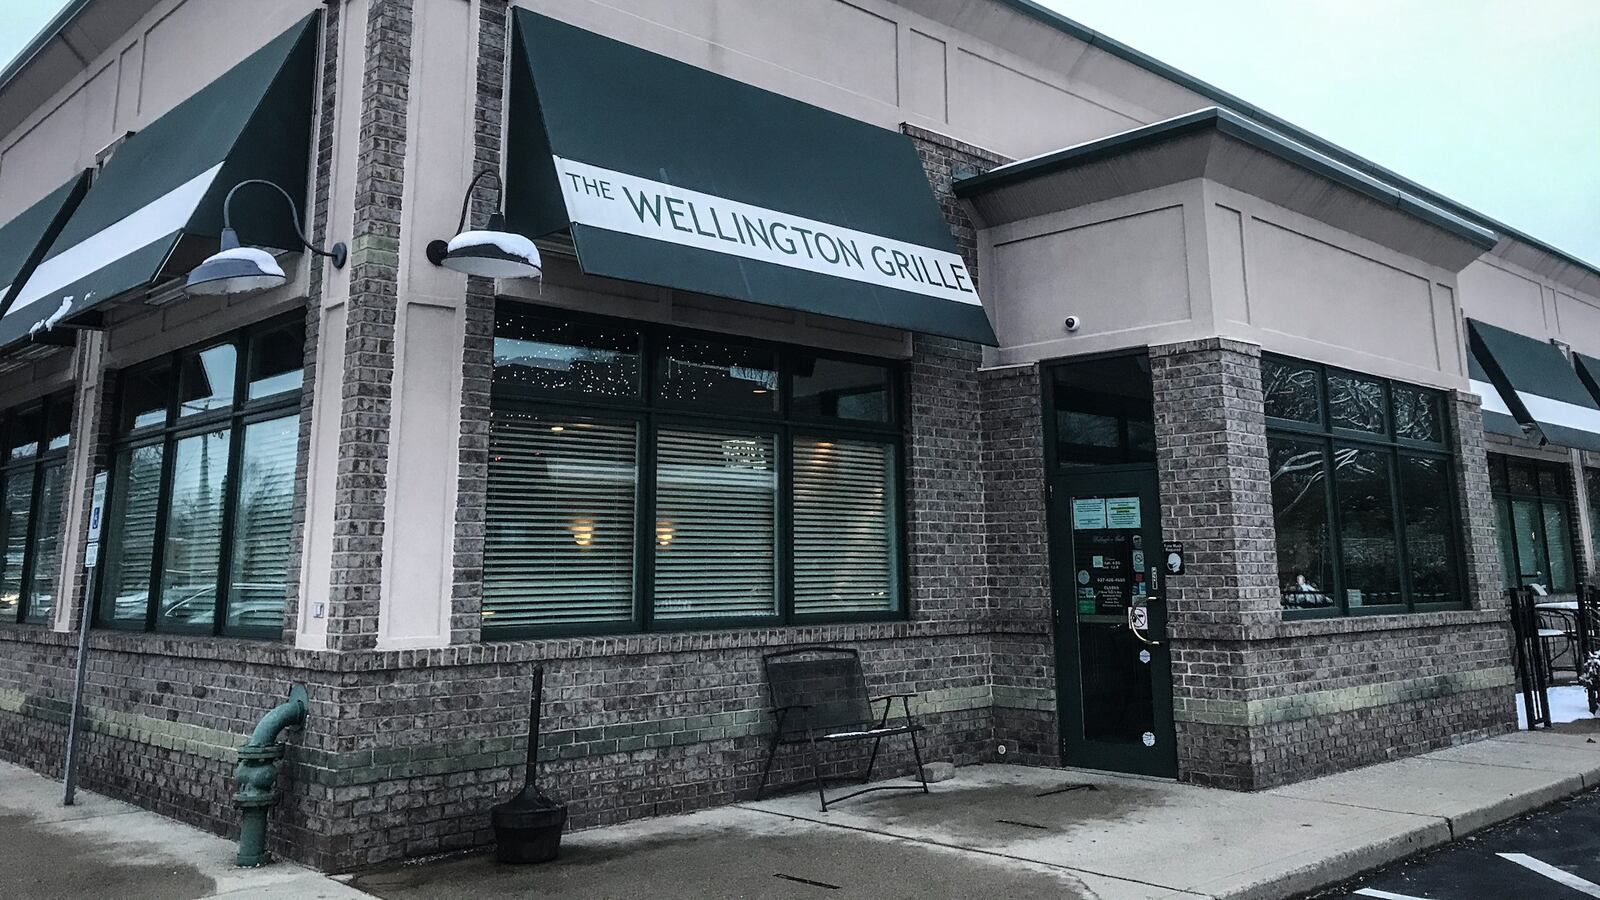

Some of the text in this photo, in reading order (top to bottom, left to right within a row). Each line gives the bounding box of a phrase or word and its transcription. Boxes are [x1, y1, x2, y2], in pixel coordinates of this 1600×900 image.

[565, 172, 973, 293] THE WELLINGTON GRILLE
